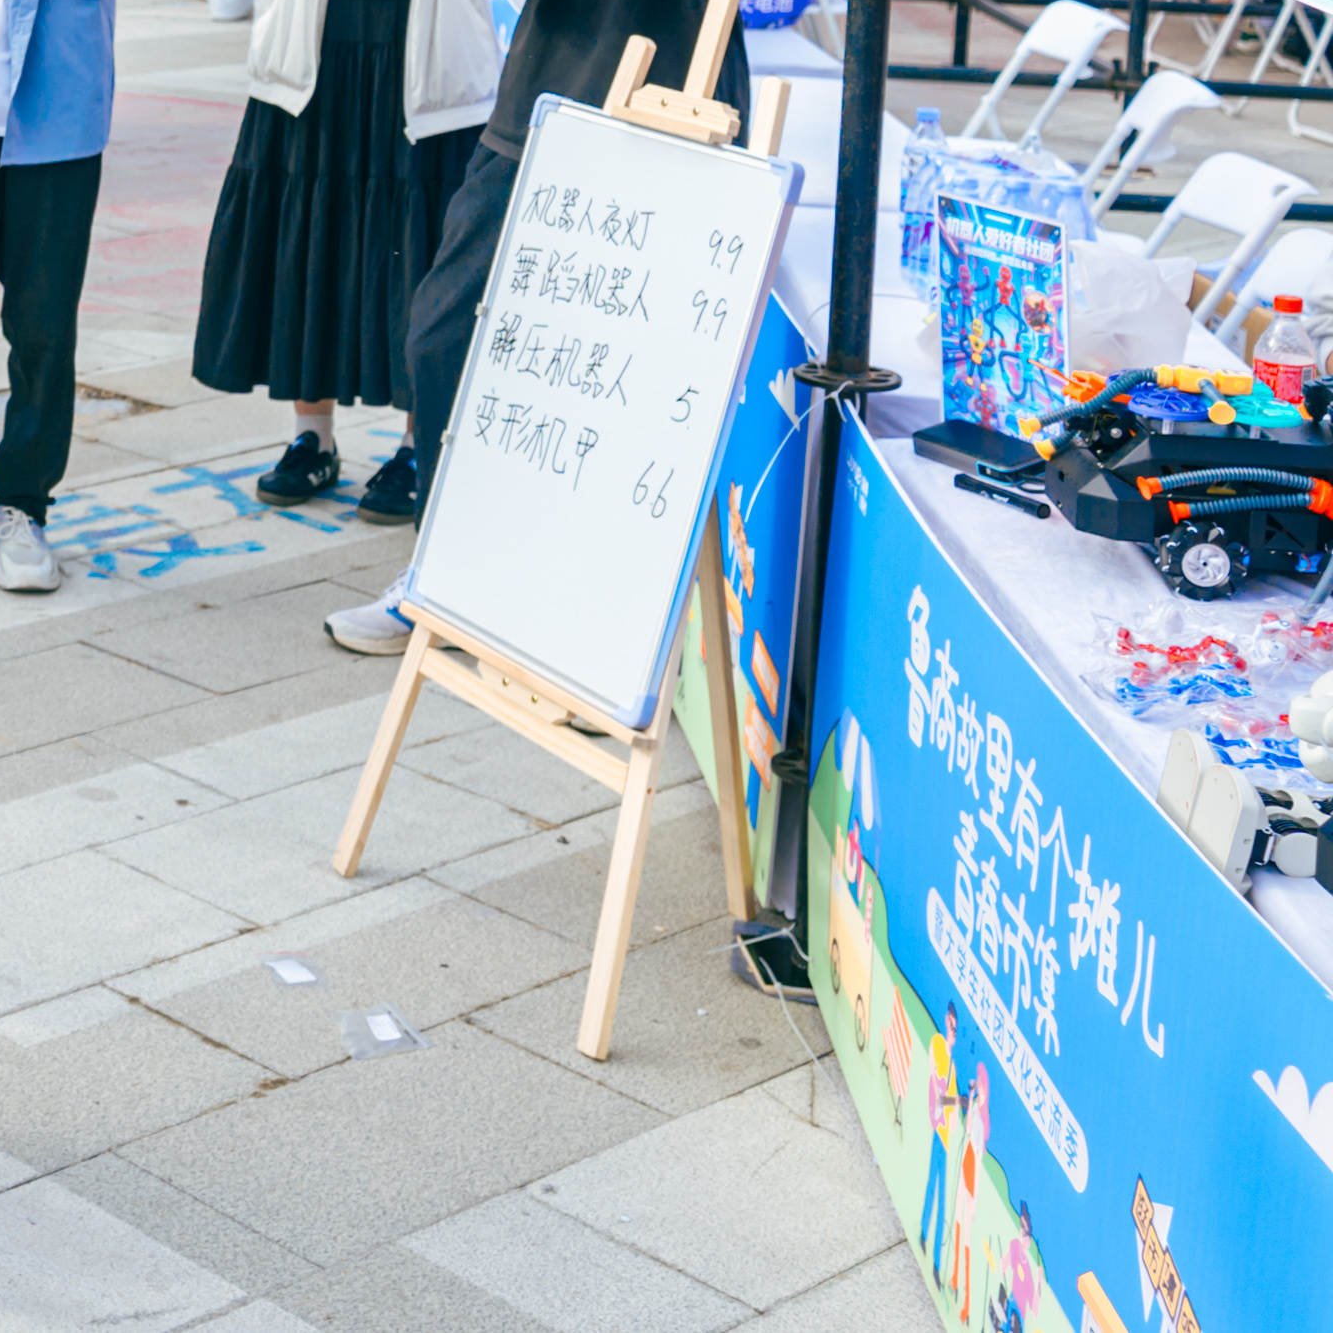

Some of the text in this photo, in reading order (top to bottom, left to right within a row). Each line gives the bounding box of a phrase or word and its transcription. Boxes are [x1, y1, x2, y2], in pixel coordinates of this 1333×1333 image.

[521, 183, 656, 251] 机器人夜灯
[945, 216, 1056, 265] 机器人爱好者社团
[509, 243, 651, 322] 舞蹈机器人
[488, 311, 633, 406] 解压机器人
[474, 387, 599, 491] 变形机甲
[905, 583, 1166, 1058] 鲁商故里有个摊儿
[954, 809, 1061, 1058] 青春市集
[931, 913, 1081, 1173] 暨大学生社团文化交流季
